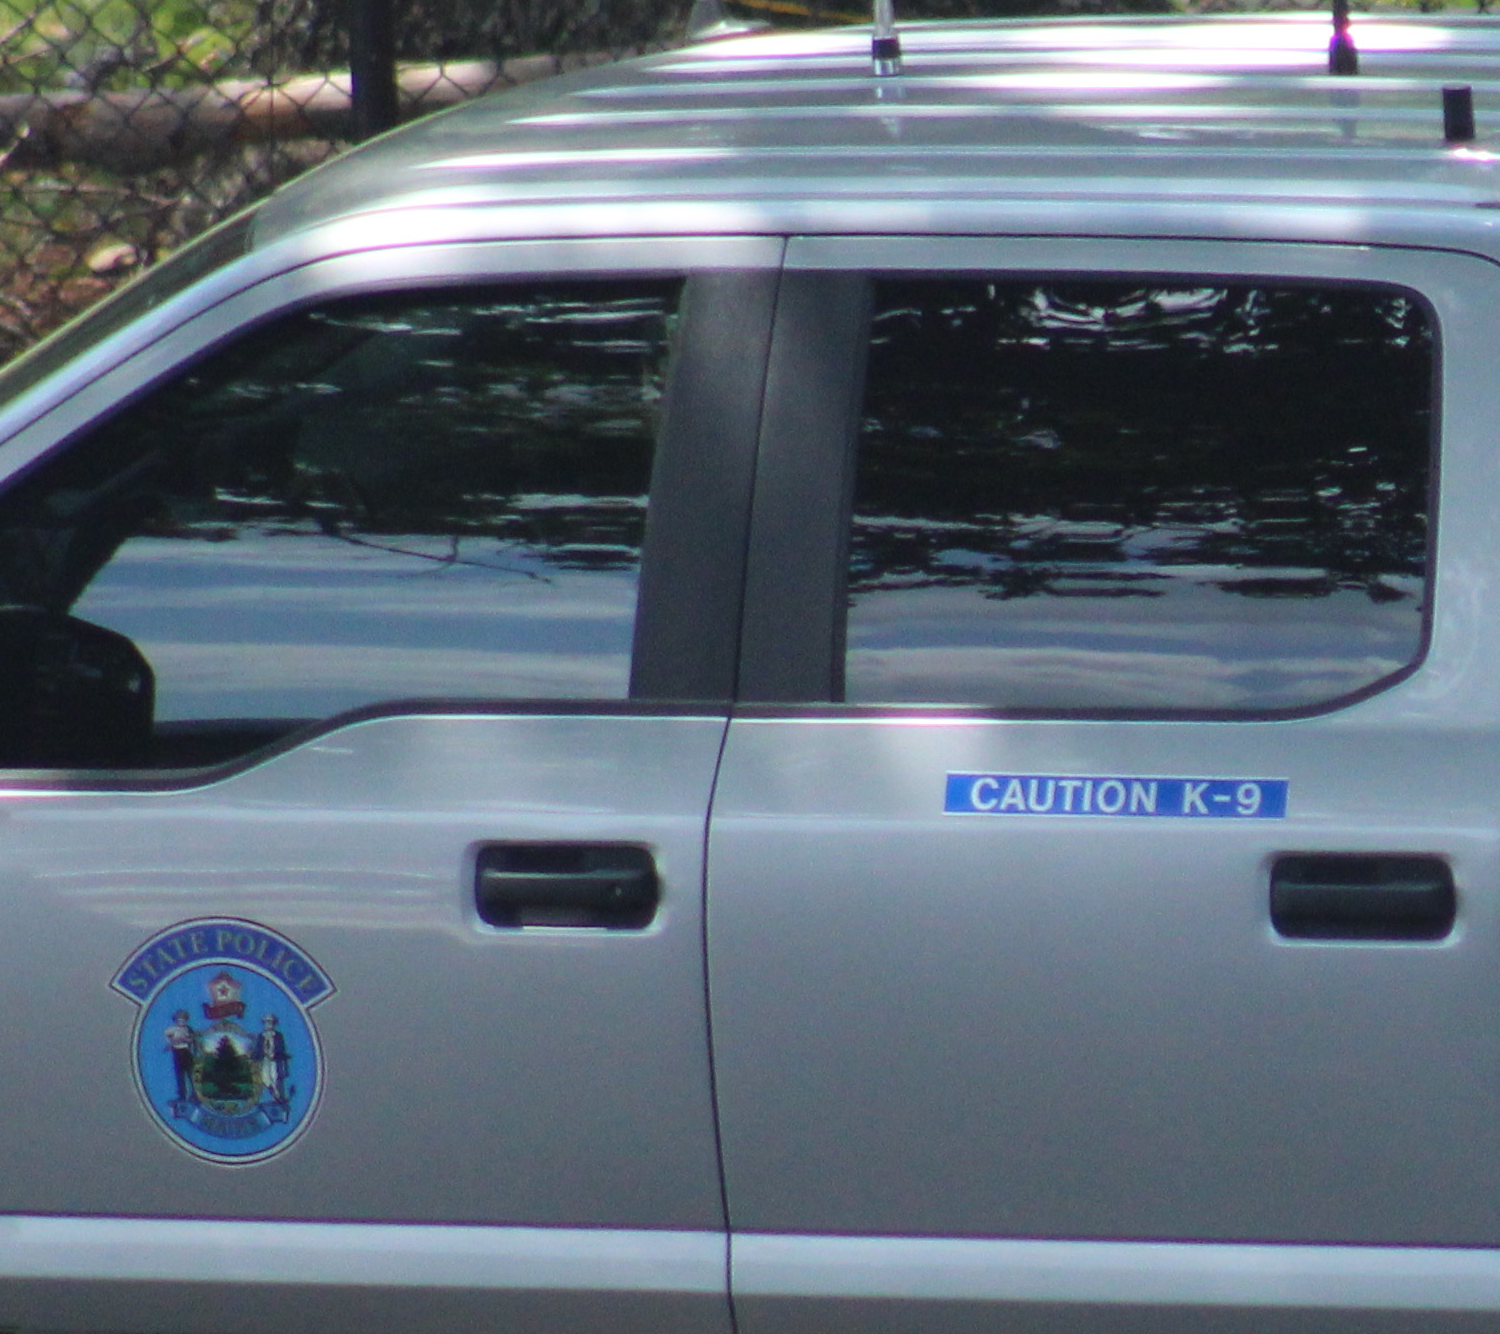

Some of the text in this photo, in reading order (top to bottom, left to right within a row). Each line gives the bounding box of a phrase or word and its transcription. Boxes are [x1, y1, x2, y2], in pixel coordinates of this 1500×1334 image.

[970, 777, 1263, 816] CAUTION K-9
[129, 928, 317, 992] STATE POLICE
